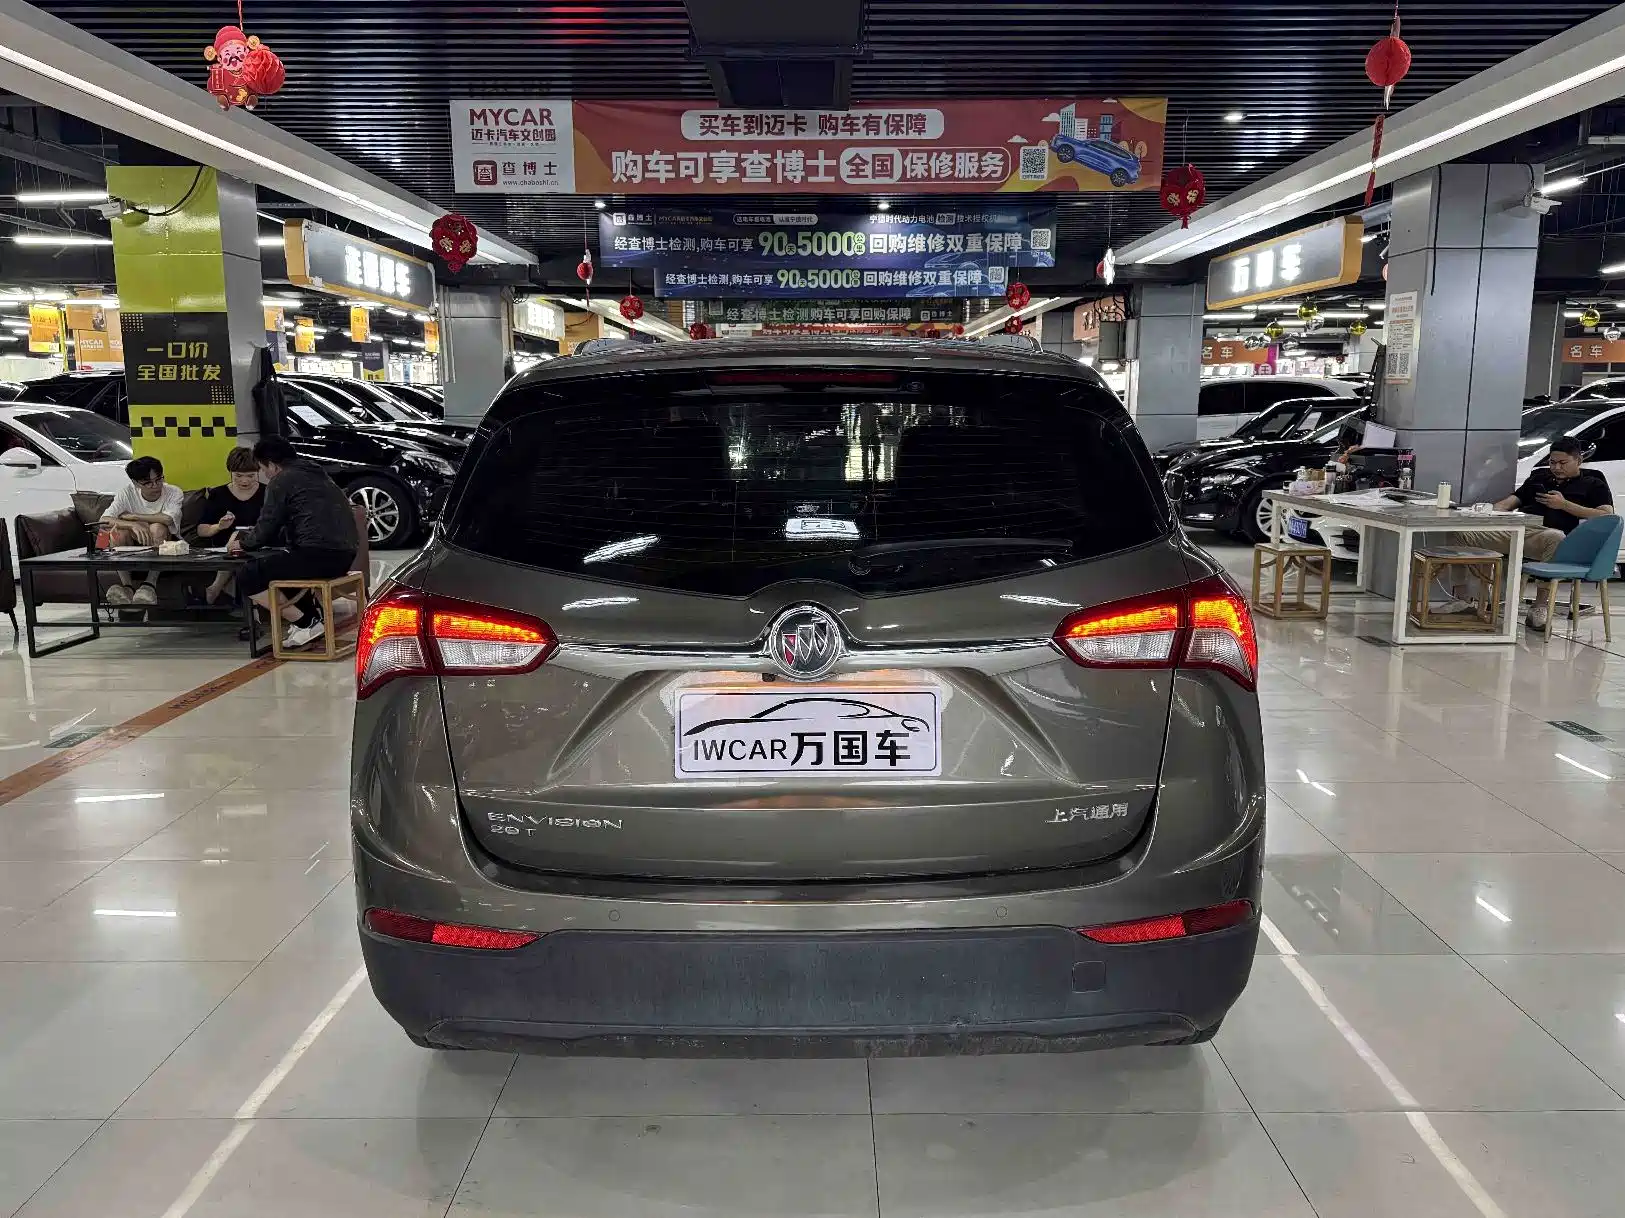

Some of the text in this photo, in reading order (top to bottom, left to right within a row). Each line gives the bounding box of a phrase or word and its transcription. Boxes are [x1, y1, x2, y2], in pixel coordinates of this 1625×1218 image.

[469, 108, 554, 126] MYCAR
[699, 113, 927, 137] 买车到迈卡 购车有保障
[471, 128, 556, 142] 迈卡汽车文创园
[502, 161, 558, 176] 查博士
[611, 150, 1005, 184] 购车可享查博士全国保修服务
[614, 236, 754, 252] 经查博士检测,购车可享
[869, 233, 1022, 254] 回购维修双重保障
[665, 273, 774, 286] 经查博士检测,购车可享
[863, 270, 982, 287] 回购维修双重保障
[726, 307, 912, 321] 经查博士检测购车可享回购保障
[146, 342, 209, 359] 一口价
[1570, 344, 1603, 358] 名车
[137, 364, 222, 381] 全国批发
[487, 811, 623, 830] ENVISION
[1045, 802, 1129, 823] 上汽通用
